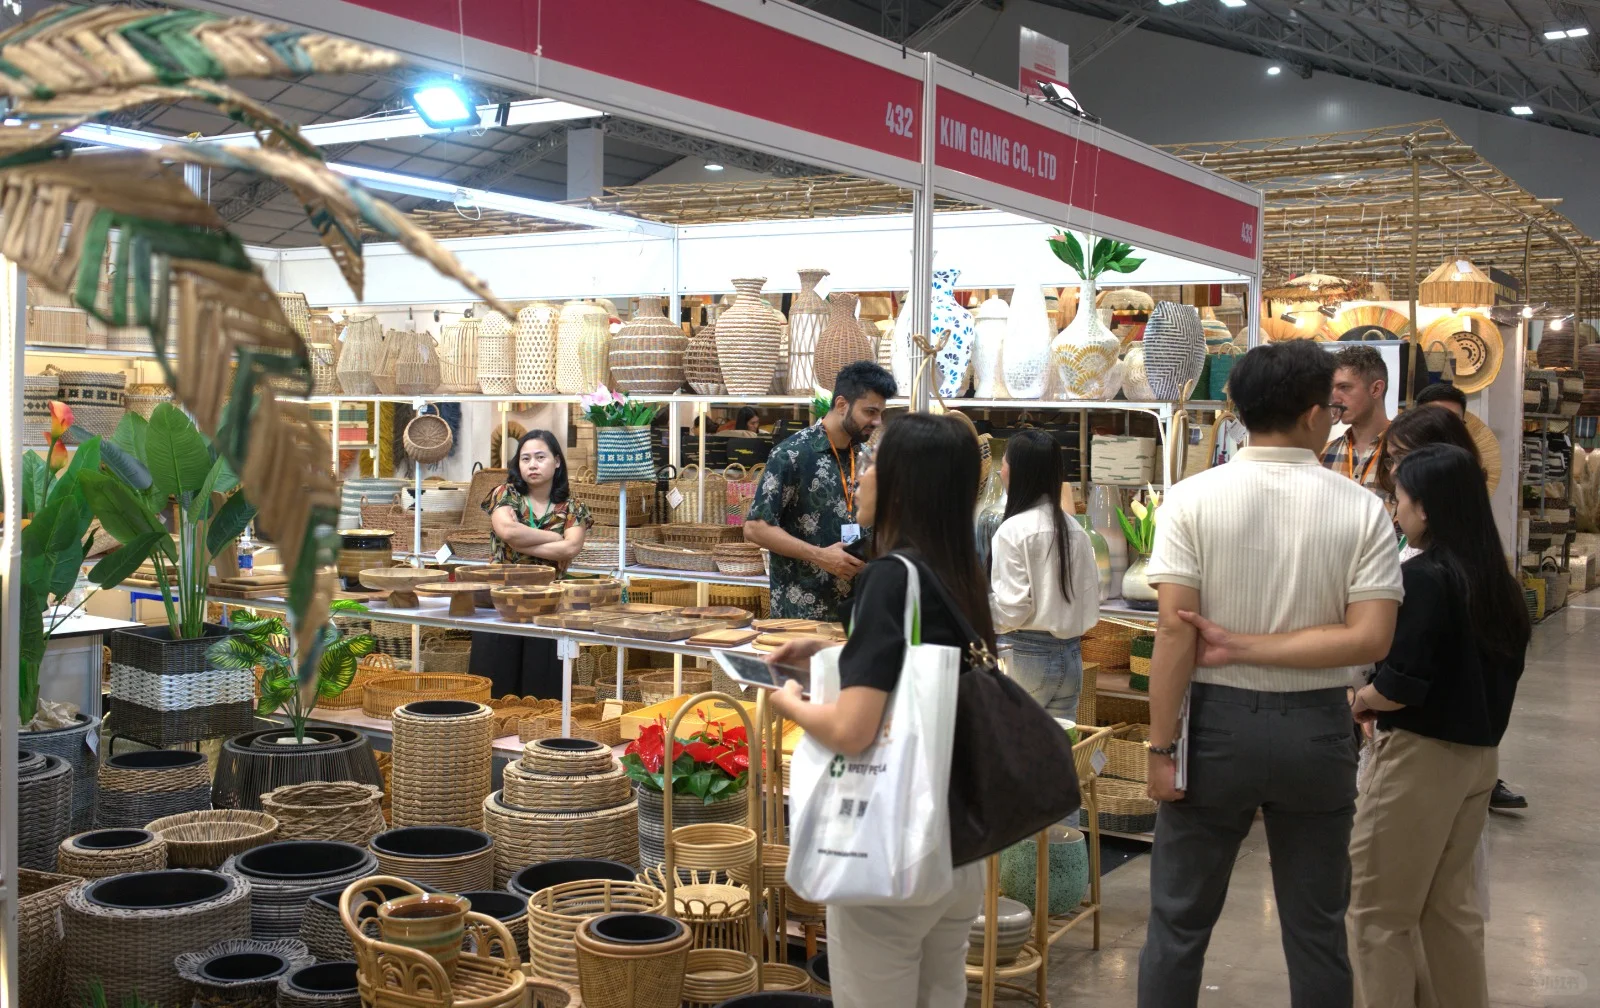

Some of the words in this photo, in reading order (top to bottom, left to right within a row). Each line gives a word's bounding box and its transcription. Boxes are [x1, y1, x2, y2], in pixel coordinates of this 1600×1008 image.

[885, 101, 914, 139] 432
[940, 115, 967, 153] KIM
[970, 126, 1010, 167] GIANG
[1012, 141, 1035, 178] CO.,
[1037, 149, 1057, 181] LTD
[1241, 221, 1253, 245] 433
